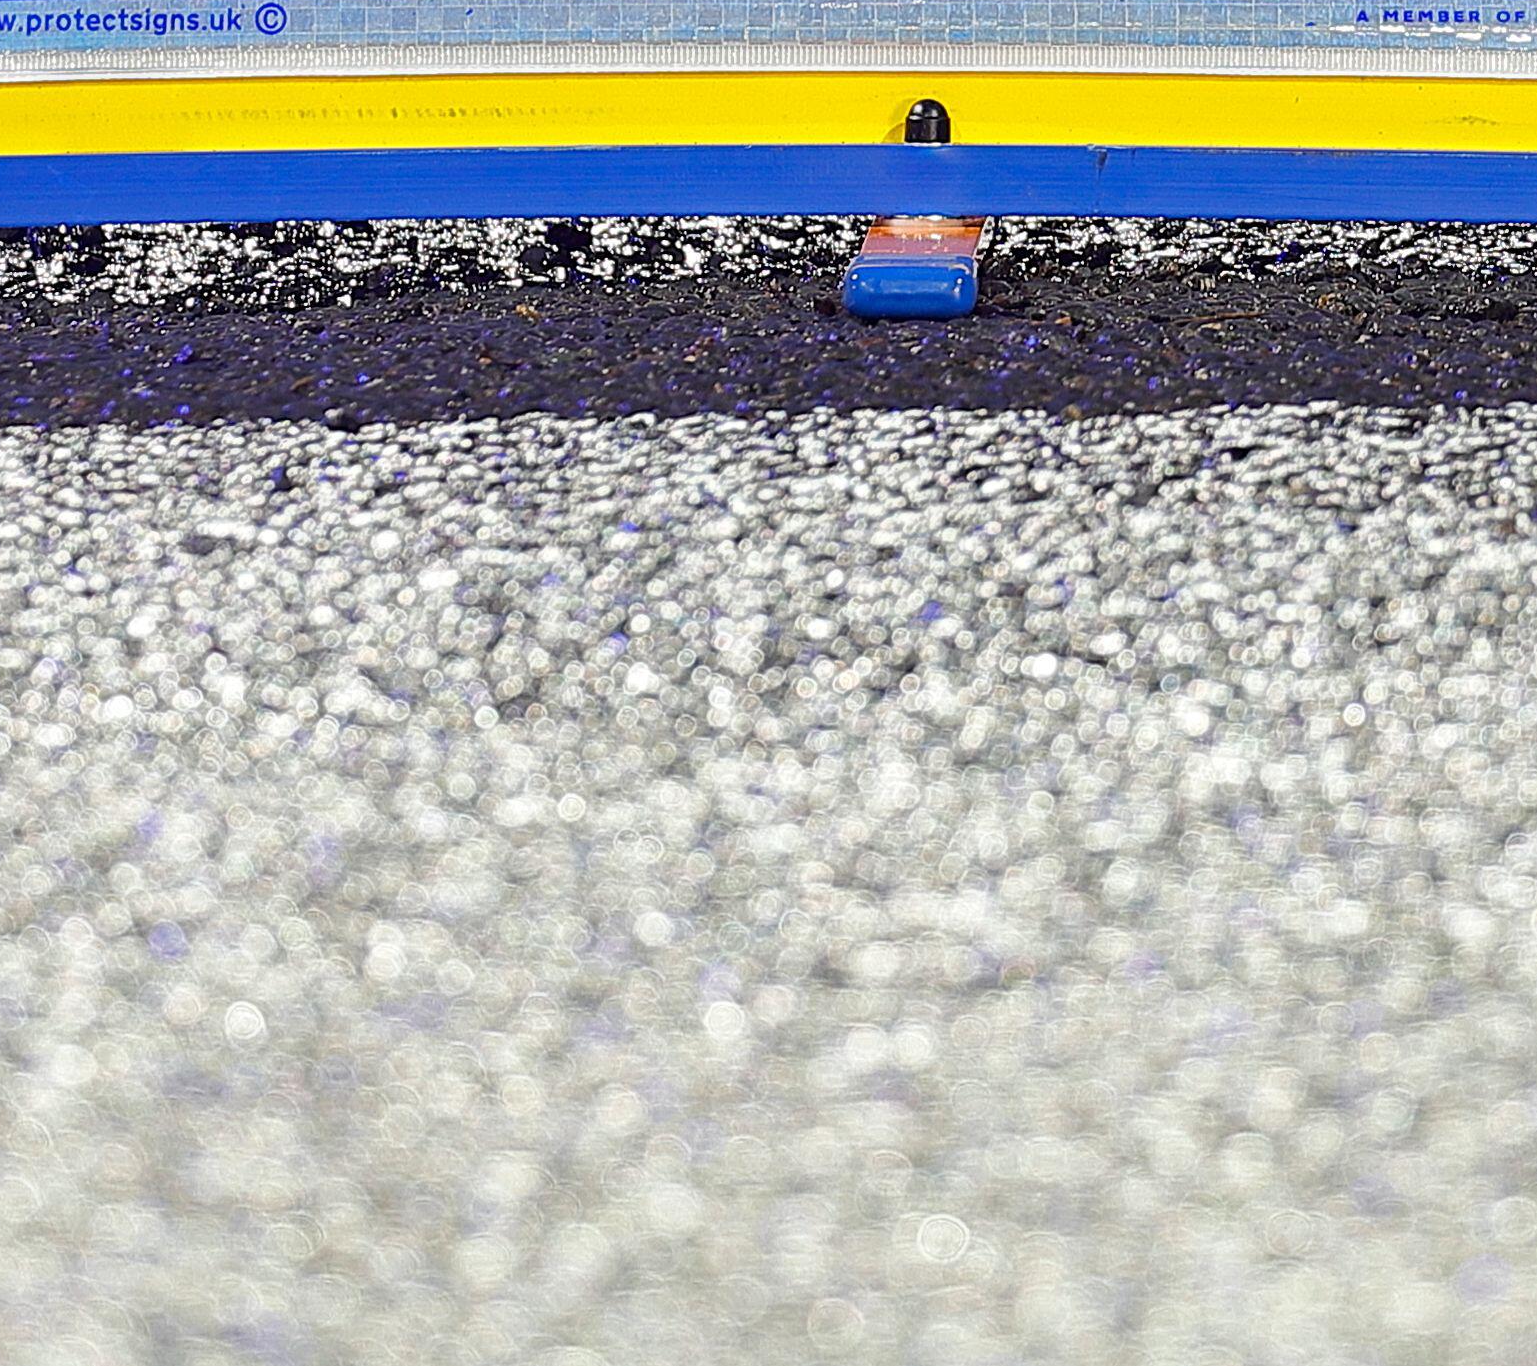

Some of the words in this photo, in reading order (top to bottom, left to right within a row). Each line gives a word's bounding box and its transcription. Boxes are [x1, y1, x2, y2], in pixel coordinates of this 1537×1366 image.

[1356, 10, 1369, 22] A
[1383, 10, 1480, 22] MEMBER
[1496, 10, 1526, 22] OF
